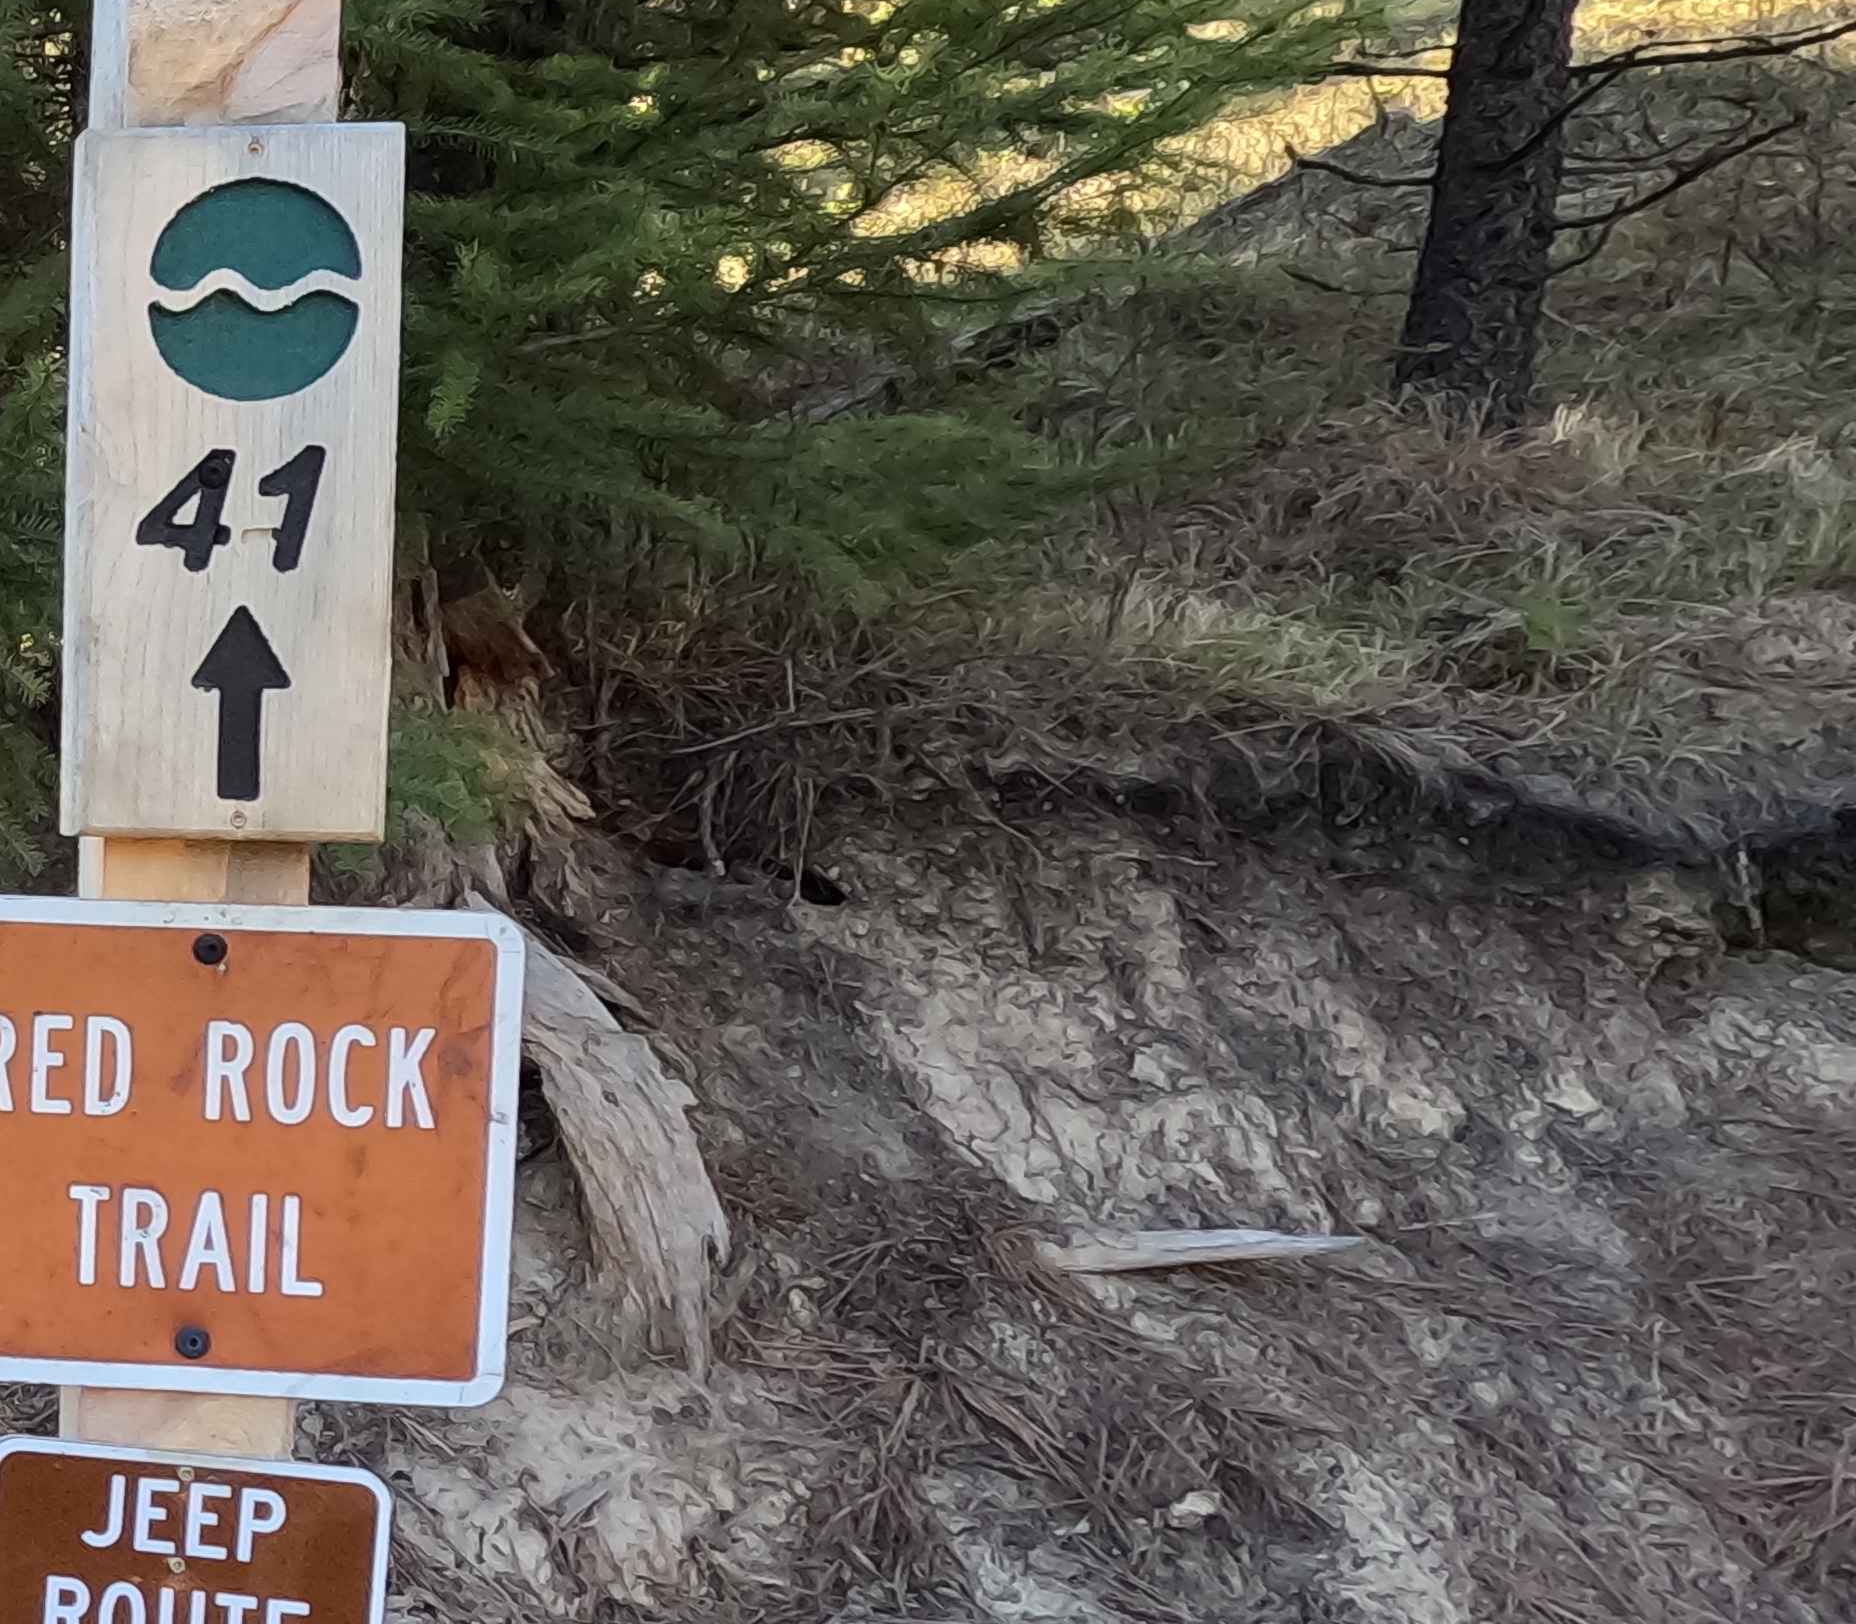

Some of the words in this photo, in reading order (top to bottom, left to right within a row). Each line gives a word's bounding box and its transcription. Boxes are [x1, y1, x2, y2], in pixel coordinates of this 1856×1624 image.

[136, 445, 326, 573] 41
[204, 1020, 437, 1130] ROCK
[69, 1184, 324, 1297] TRAIL
[80, 1474, 287, 1563] JEEP
